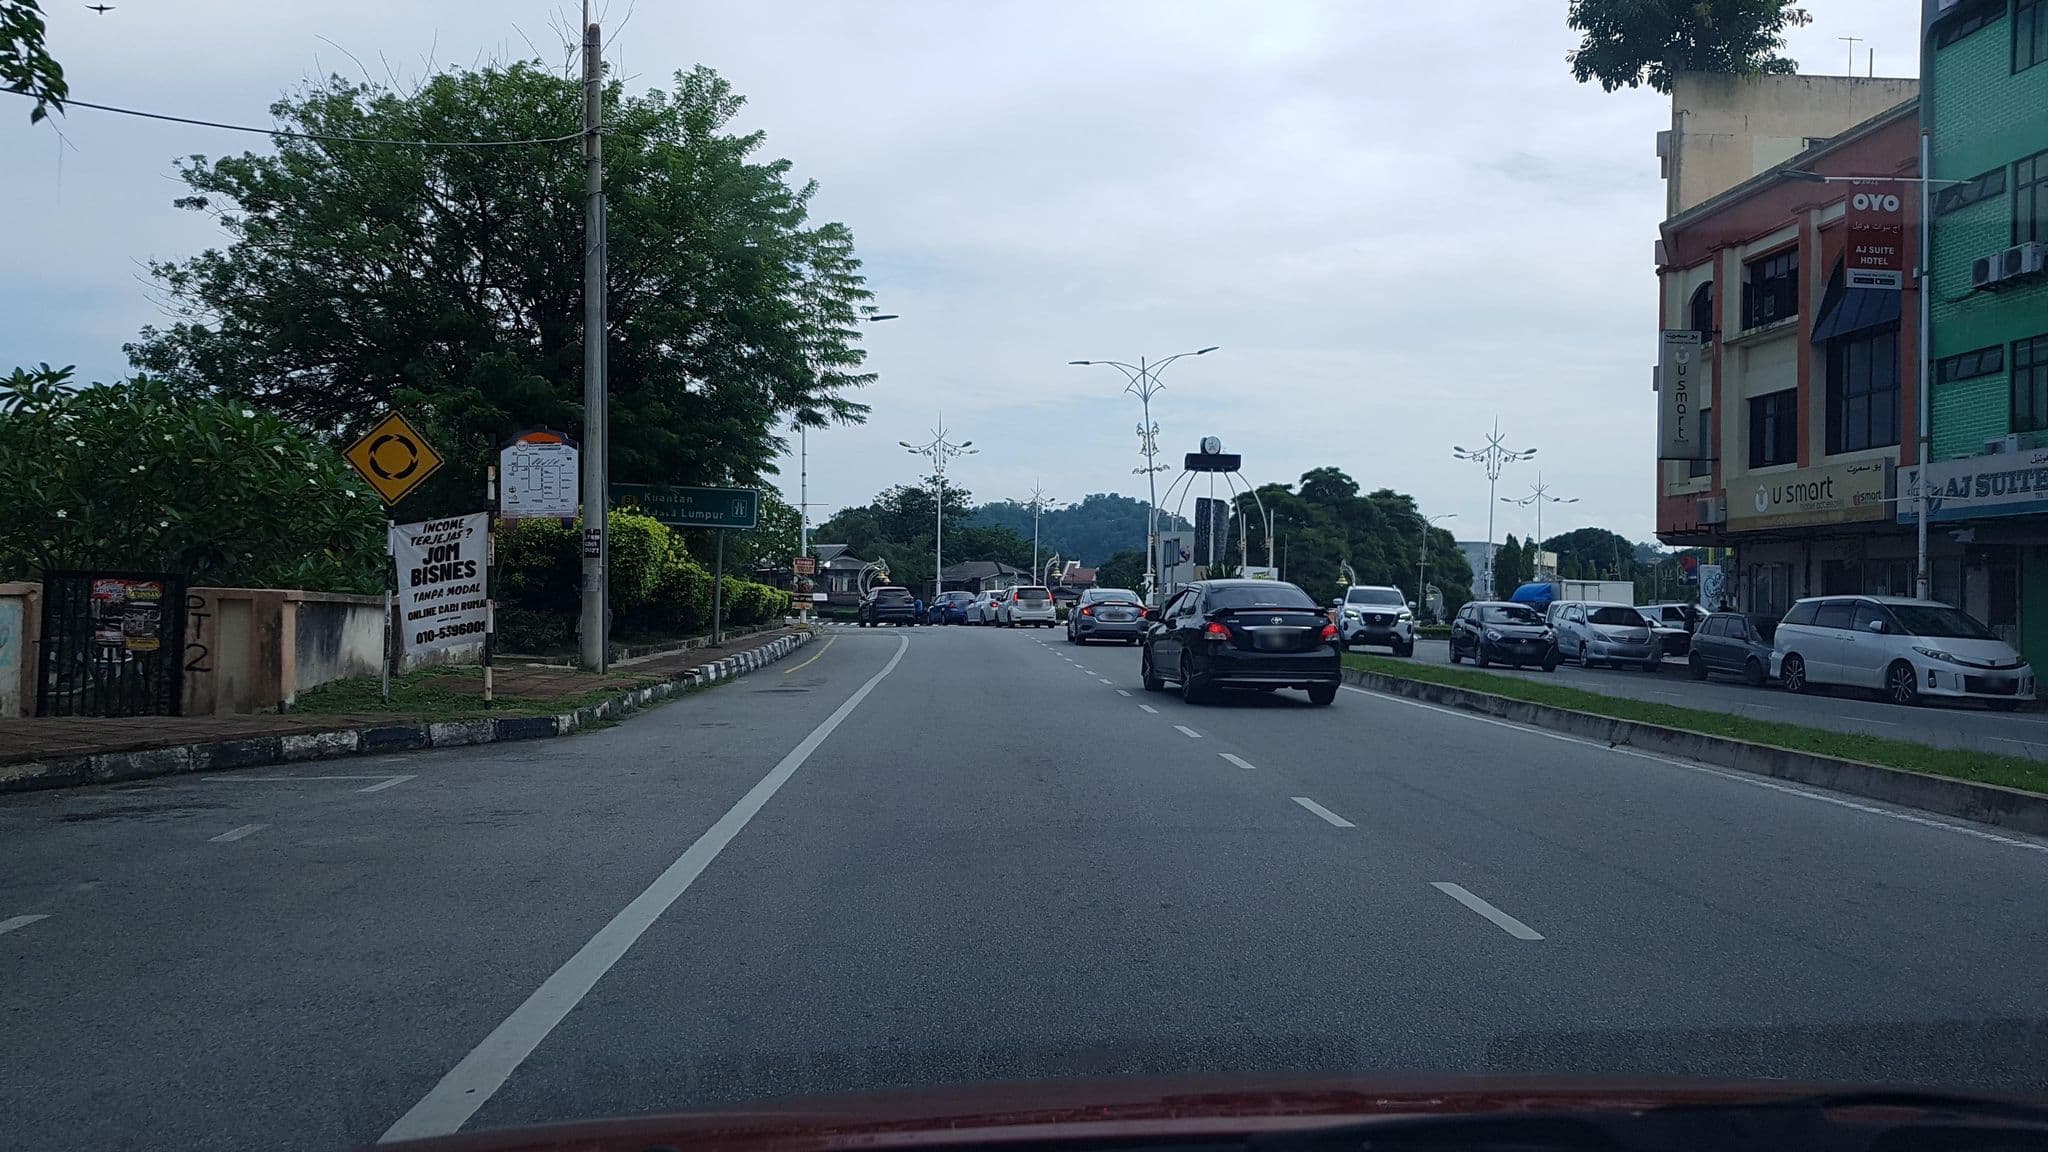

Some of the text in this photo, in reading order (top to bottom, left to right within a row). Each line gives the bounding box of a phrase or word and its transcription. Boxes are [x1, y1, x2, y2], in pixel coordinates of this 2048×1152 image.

[1852, 193, 1900, 212] OYO
[1855, 246, 1895, 255] AJ SUITE
[1860, 256, 1889, 265] HOTEL
[1786, 475, 1833, 503] smart
[1945, 467, 2048, 498] AJ SUITE
[644, 493, 694, 504] Kuantan
[681, 508, 725, 520] Lumpur
[423, 518, 465, 534] INCOME
[410, 529, 462, 546] TERJEJAS
[422, 542, 460, 565] JOM
[411, 559, 477, 587] BISNES
[413, 583, 481, 603] TANPA MODAL
[407, 606, 437, 621] ONLINE
[438, 602, 459, 614] DARI
